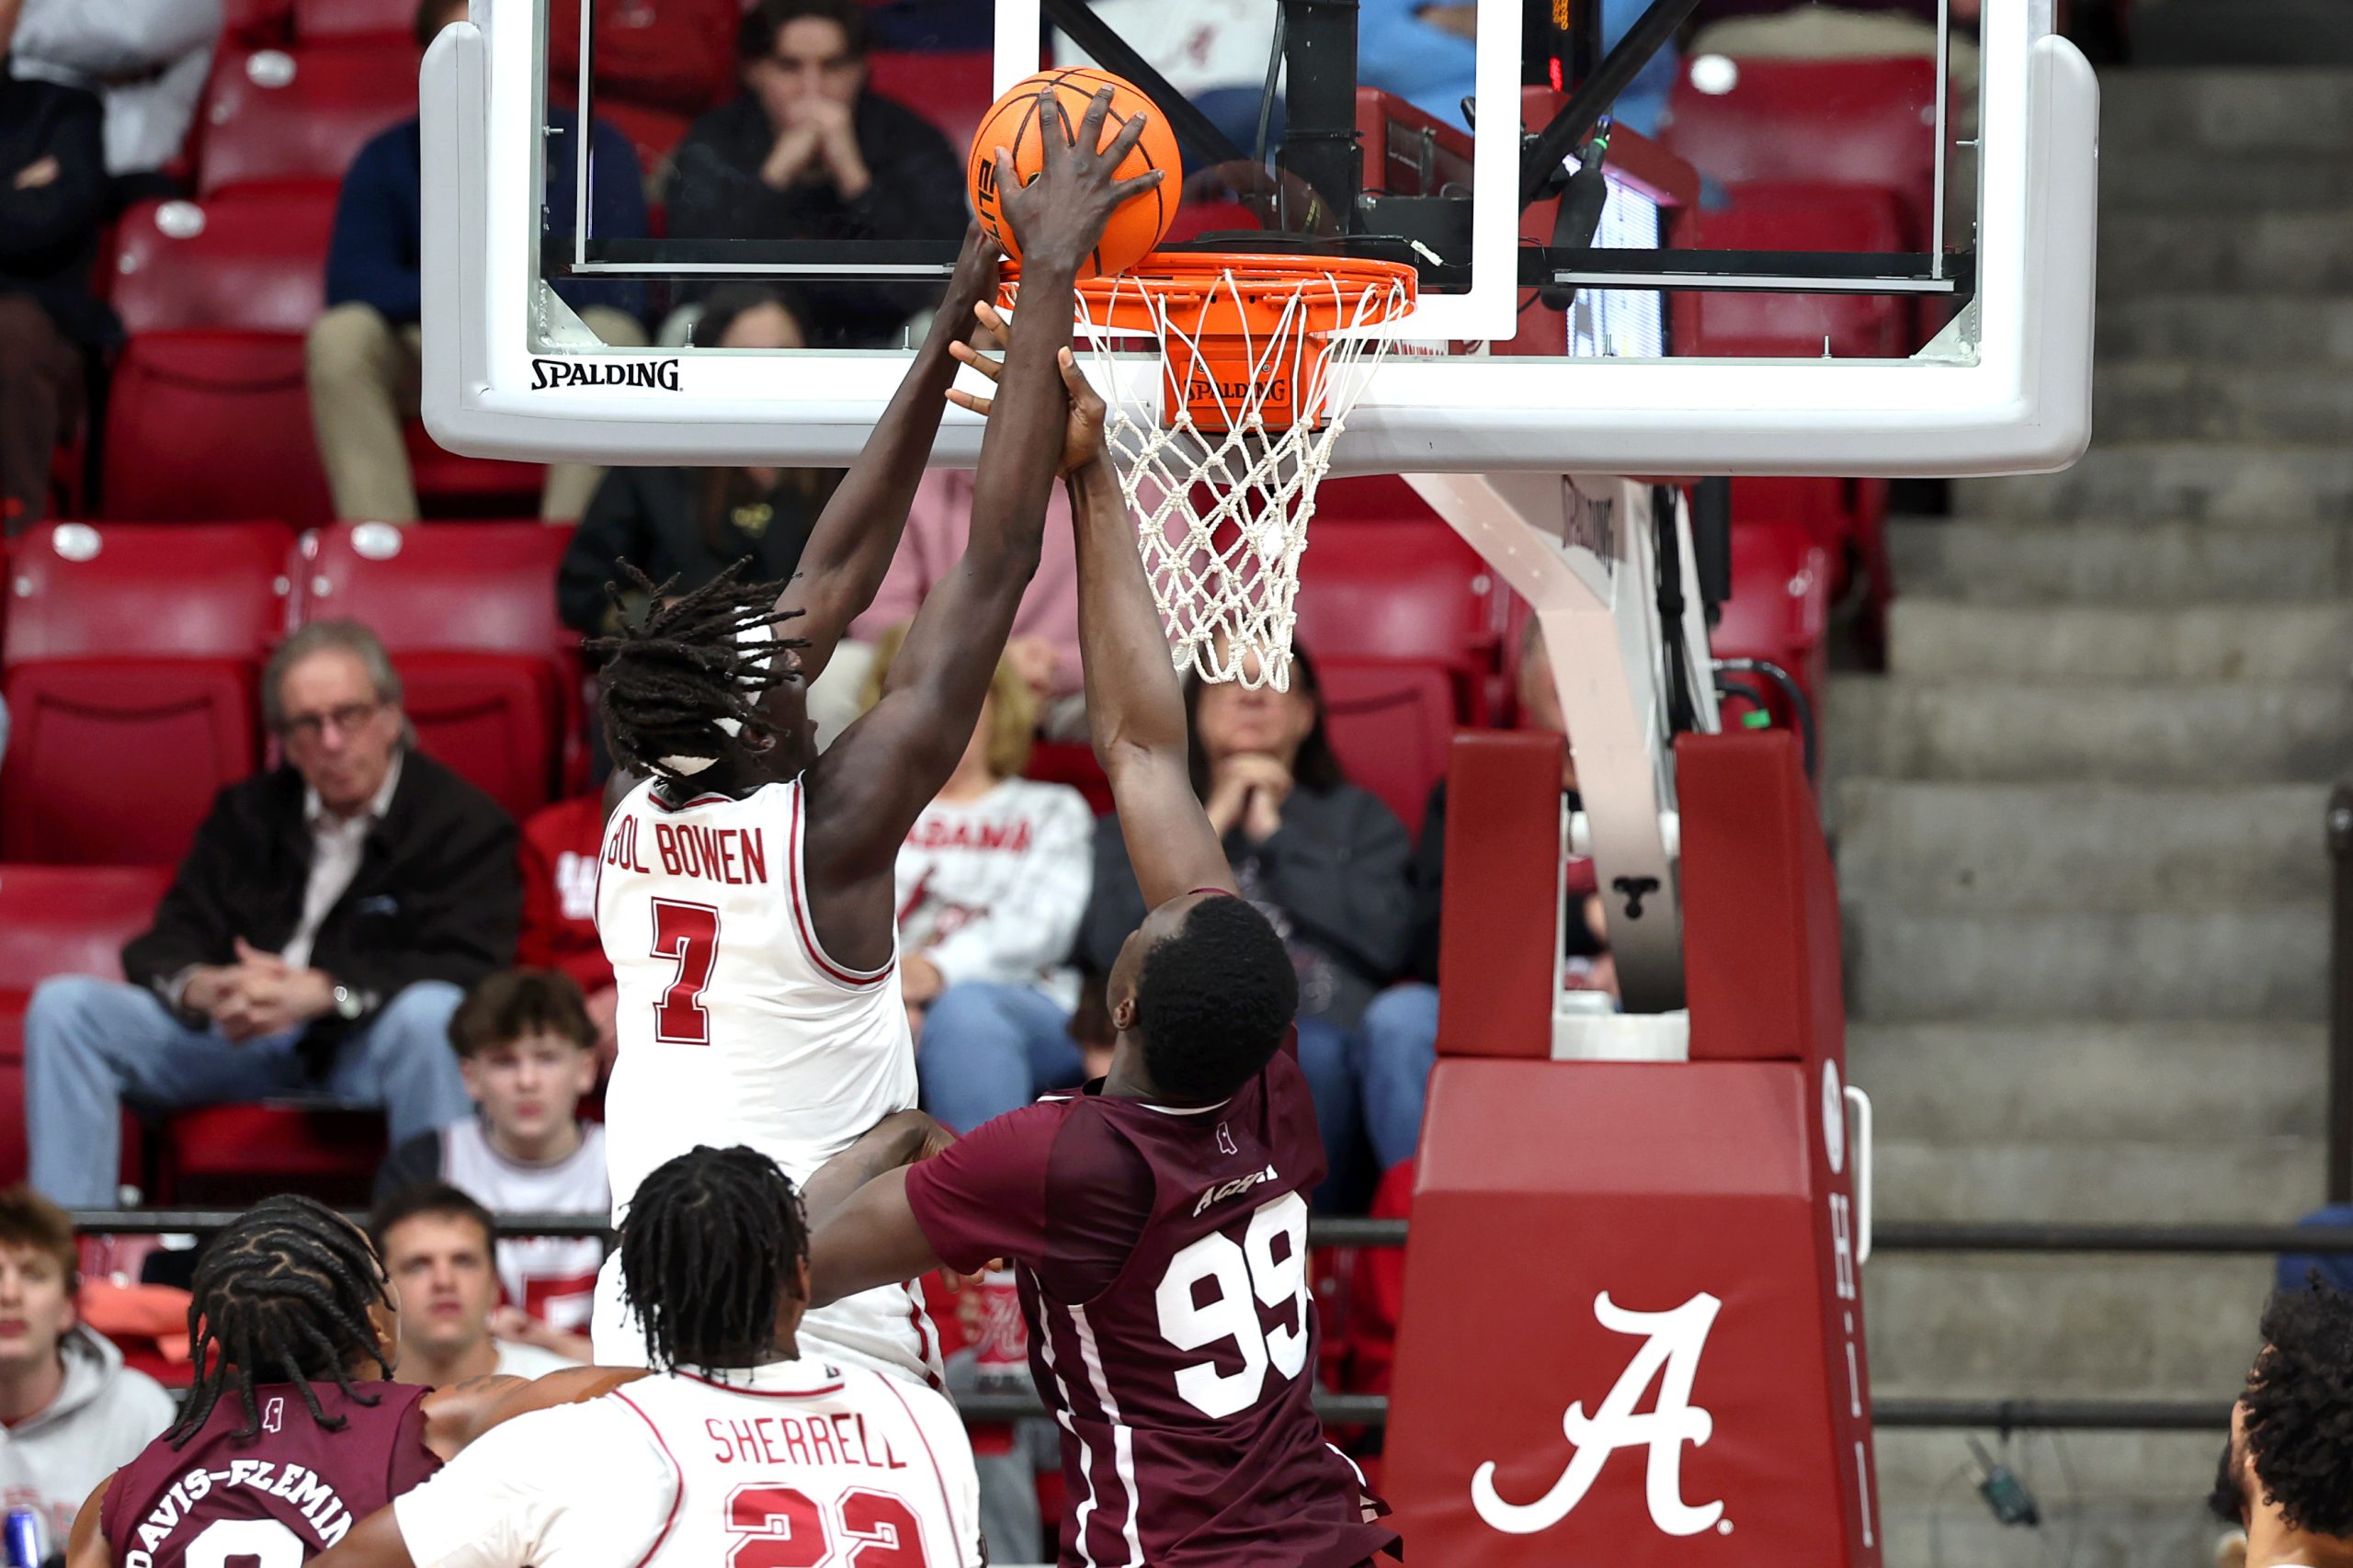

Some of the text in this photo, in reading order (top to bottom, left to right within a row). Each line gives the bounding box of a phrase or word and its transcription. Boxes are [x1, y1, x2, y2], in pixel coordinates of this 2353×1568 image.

[531, 358, 678, 392] SPALDING
[1184, 379, 1285, 402] SPALDNG
[655, 824, 767, 884] BOWEN
[650, 896, 721, 1046] 7
[1155, 1190, 1308, 1419] 99
[705, 1414, 907, 1469] SHERRELL
[1471, 1290, 1724, 1537] A
[725, 1482, 932, 1568] 22
